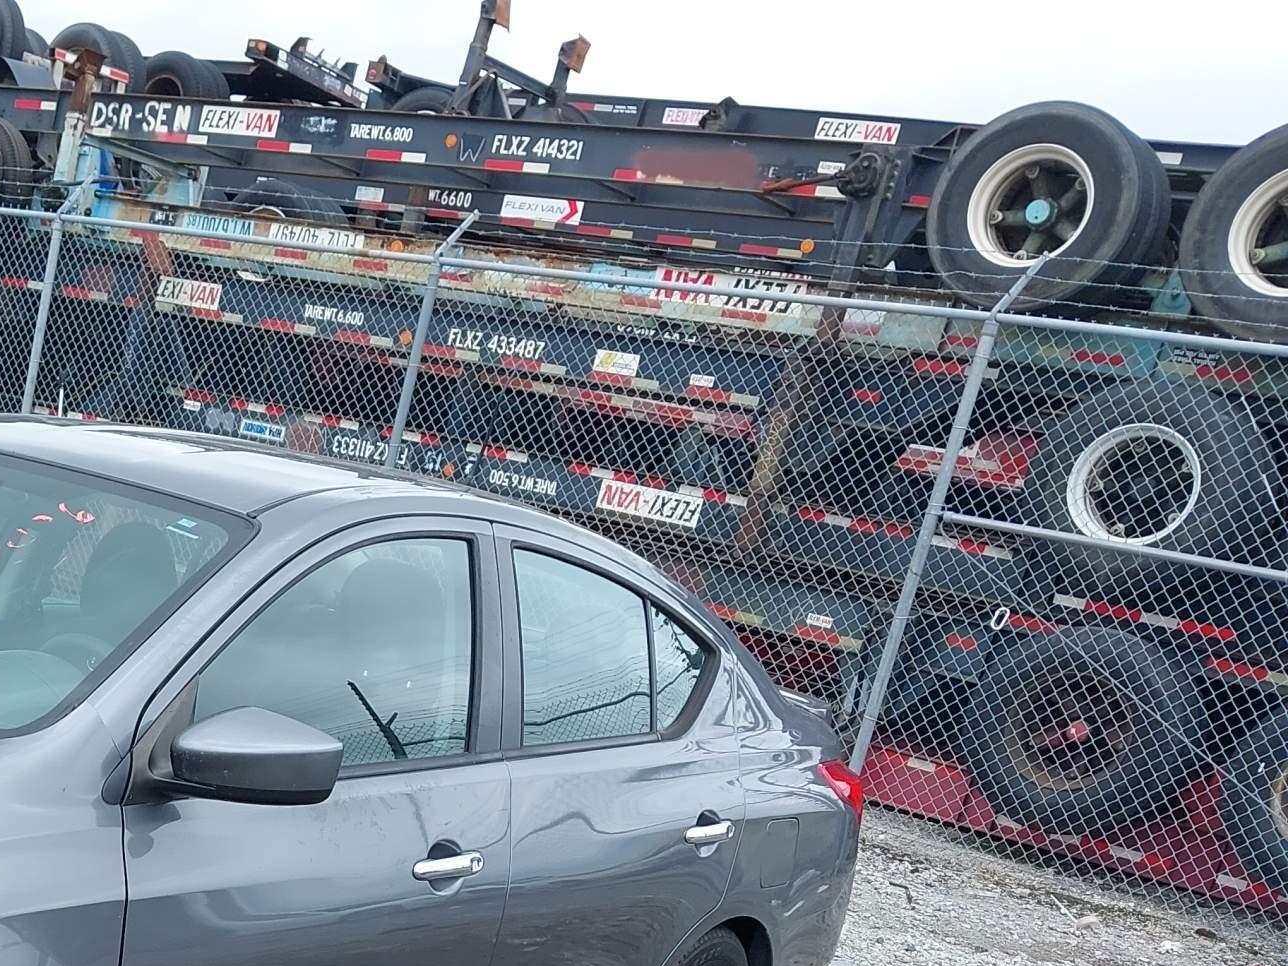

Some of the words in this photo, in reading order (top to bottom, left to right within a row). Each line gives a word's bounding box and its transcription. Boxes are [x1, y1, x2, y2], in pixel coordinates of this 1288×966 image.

[201, 109, 278, 134] FLEXI-VAN
[816, 120, 898, 143] FLEXI-VAN
[491, 135, 531, 157] FLXZ
[532, 138, 585, 161] 414321
[447, 328, 484, 350] FLXZ
[487, 335, 546, 359] 433487
[600, 483, 700, 524] FLEXI-VAN
